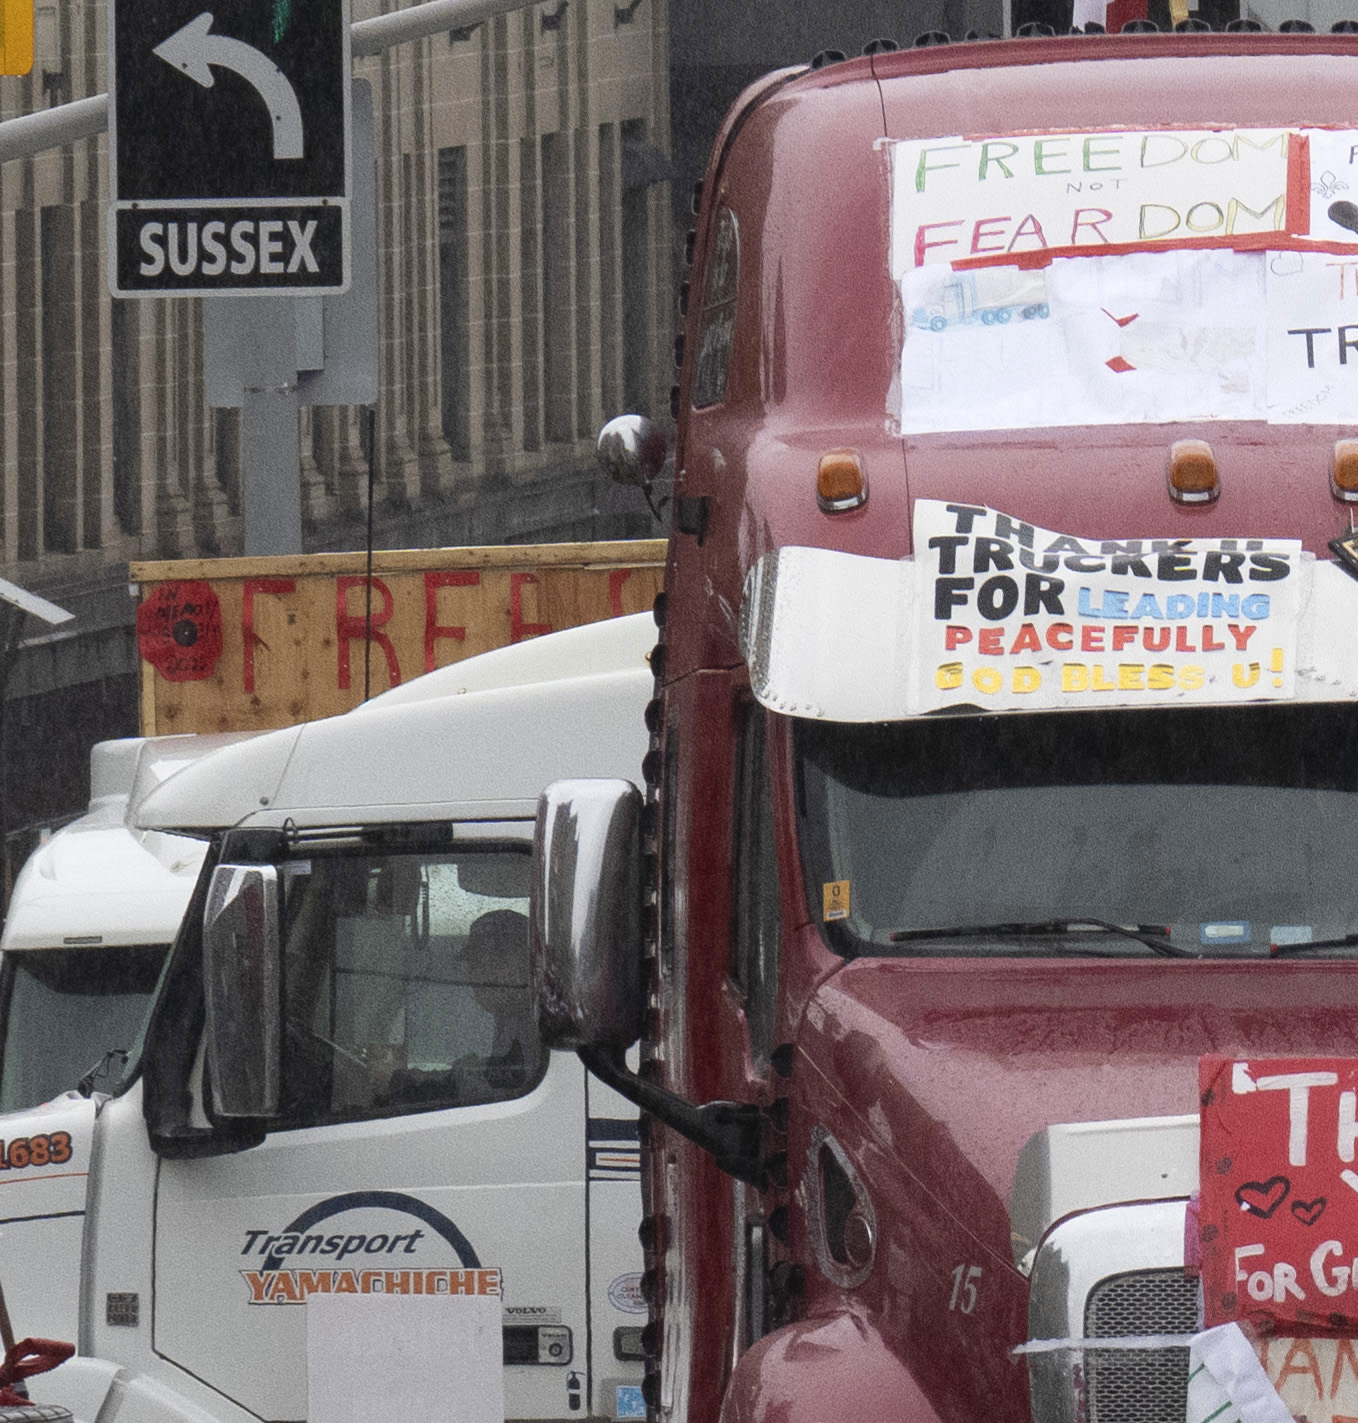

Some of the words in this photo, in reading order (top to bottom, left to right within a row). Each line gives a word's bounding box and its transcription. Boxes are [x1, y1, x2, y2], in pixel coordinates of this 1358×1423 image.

[915, 131, 1288, 192] FREEDOM
[1066, 177, 1129, 194] NOT
[139, 219, 320, 277] SUSSEX
[945, 504, 1193, 555] THANK
[928, 535, 1292, 585] TRUCKERS
[934, 573, 1066, 622] FOR
[1077, 586, 1272, 621] LEADING
[944, 623, 1258, 656] PEACEFULLY
[935, 660, 1043, 694] GOD
[1060, 662, 1207, 693] BLESS
[241, 1230, 426, 1261] Transport
[506, 1306, 546, 1314] VOLVO
[949, 1264, 982, 1314] 15
